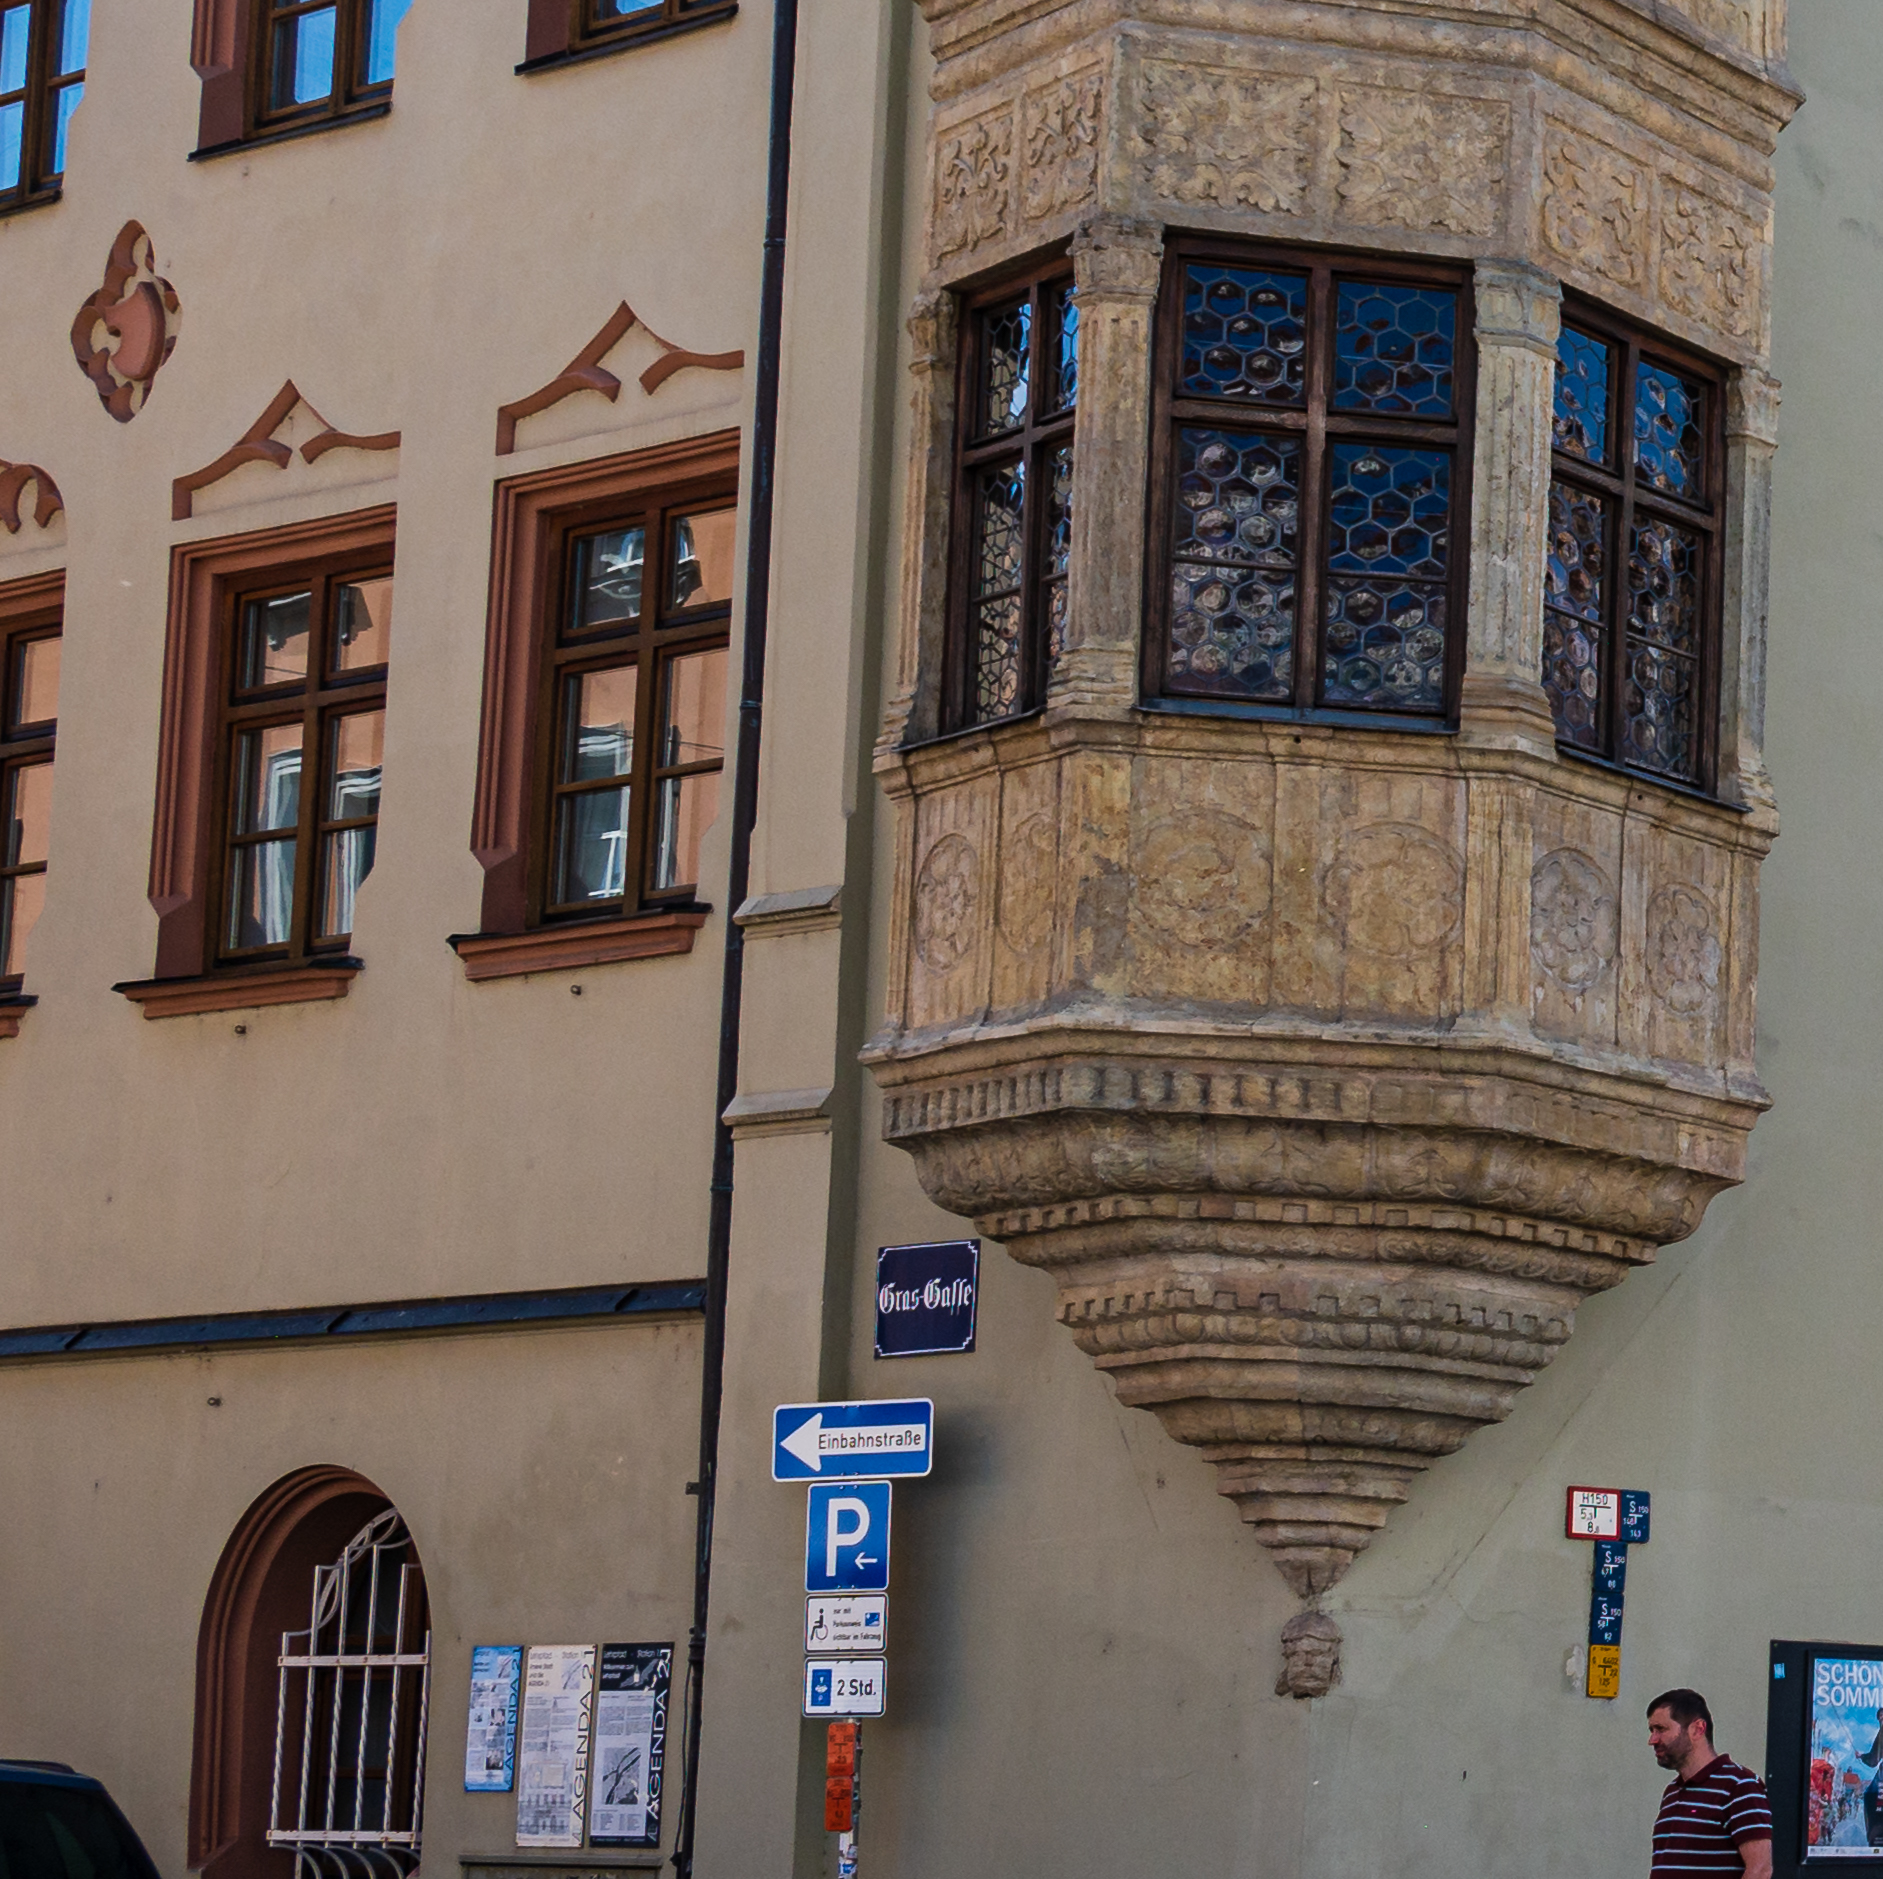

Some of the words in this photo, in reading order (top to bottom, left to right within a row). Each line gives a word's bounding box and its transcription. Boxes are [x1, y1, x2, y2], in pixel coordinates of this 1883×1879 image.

[818, 1430, 922, 1450] Einbahnstraße
[826, 1497, 870, 1577] P
[837, 1679, 845, 1696] 2
[850, 1678, 877, 1696] Std.
[573, 1691, 592, 1820] AGENDA
[646, 1689, 668, 1820] AGENDA
